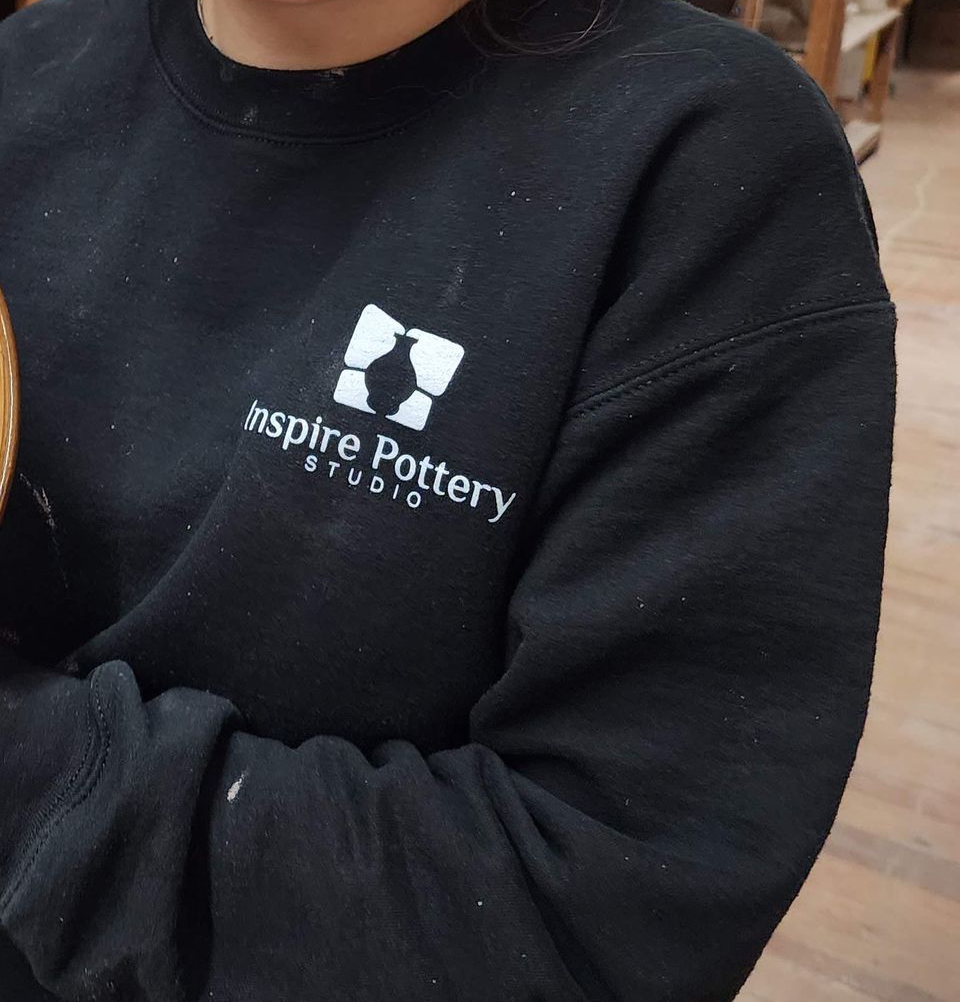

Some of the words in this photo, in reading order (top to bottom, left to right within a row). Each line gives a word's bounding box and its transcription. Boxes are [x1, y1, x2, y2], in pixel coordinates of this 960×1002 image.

[243, 399, 361, 461] Inspire
[371, 434, 517, 523] Pottery
[304, 454, 422, 509] STUDIO
